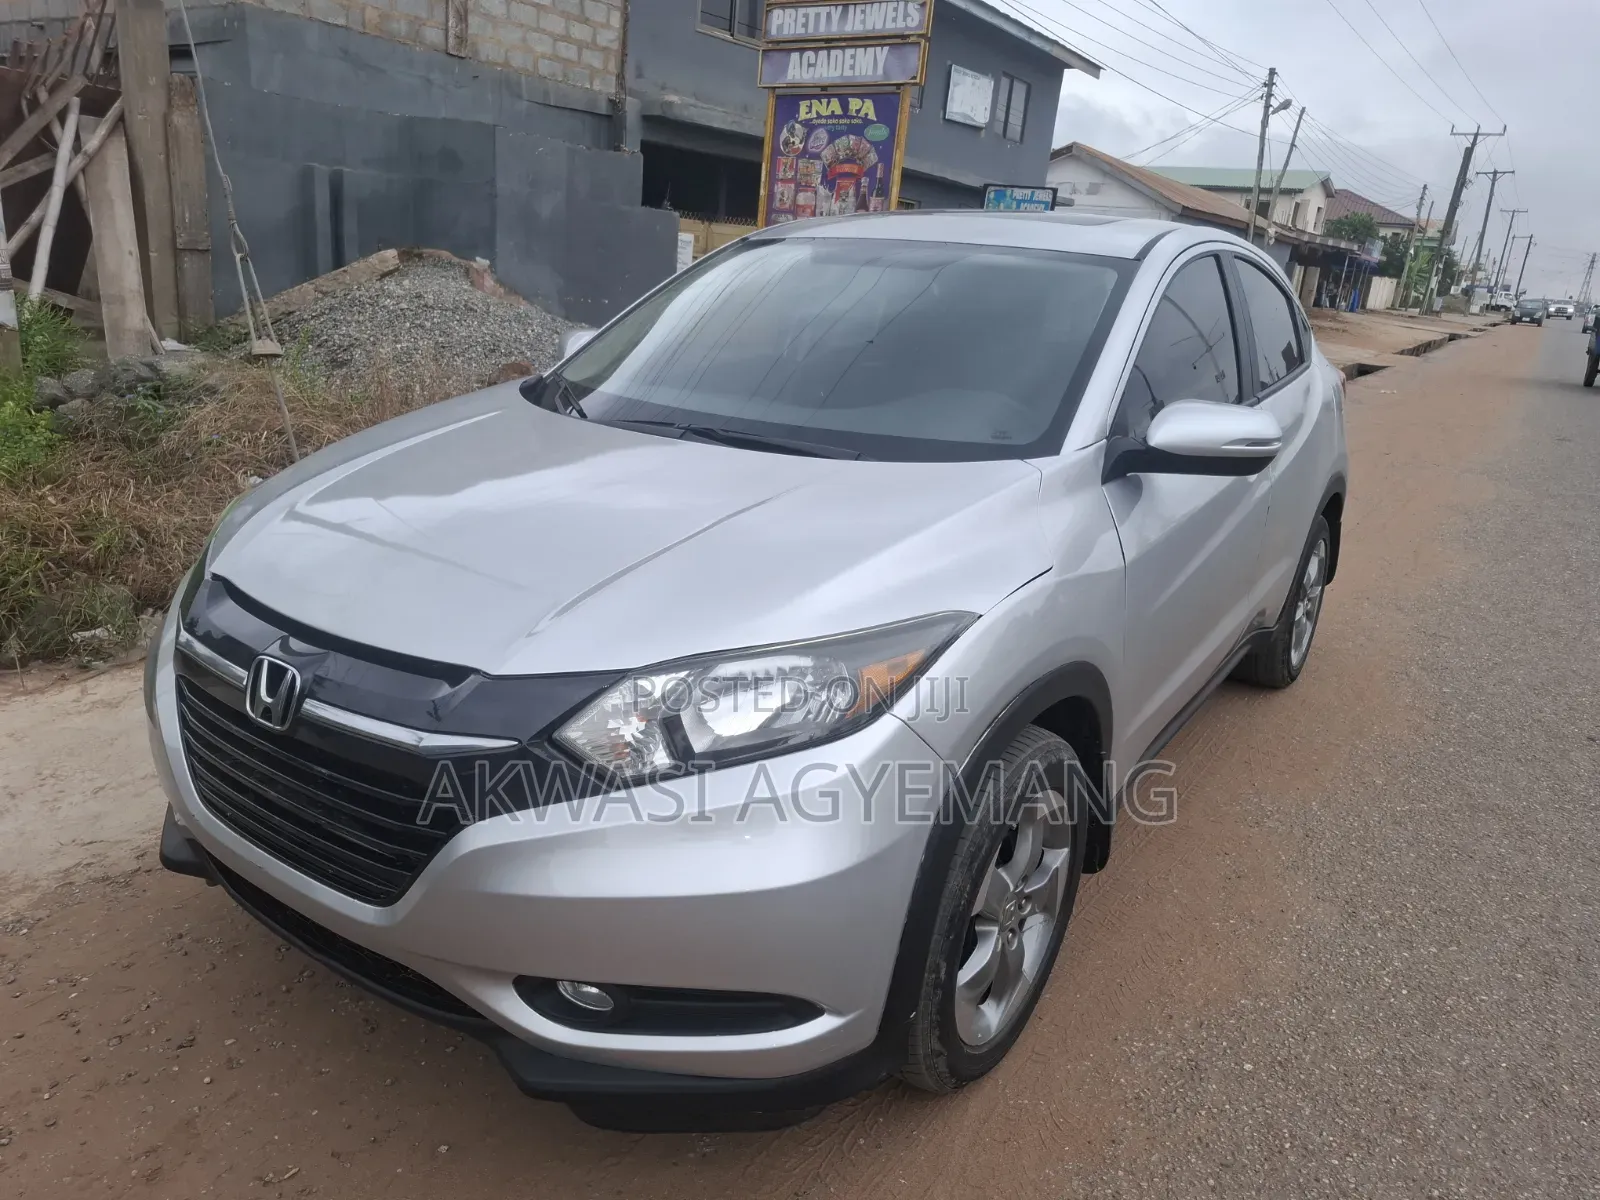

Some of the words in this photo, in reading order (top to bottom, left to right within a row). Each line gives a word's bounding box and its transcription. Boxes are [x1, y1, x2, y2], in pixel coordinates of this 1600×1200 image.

[771, 7, 842, 36] PRETTY
[844, 2, 920, 31] JEWELS
[787, 46, 889, 80] ACADEMY
[798, 98, 843, 121] ENA
[847, 98, 877, 121] PA
